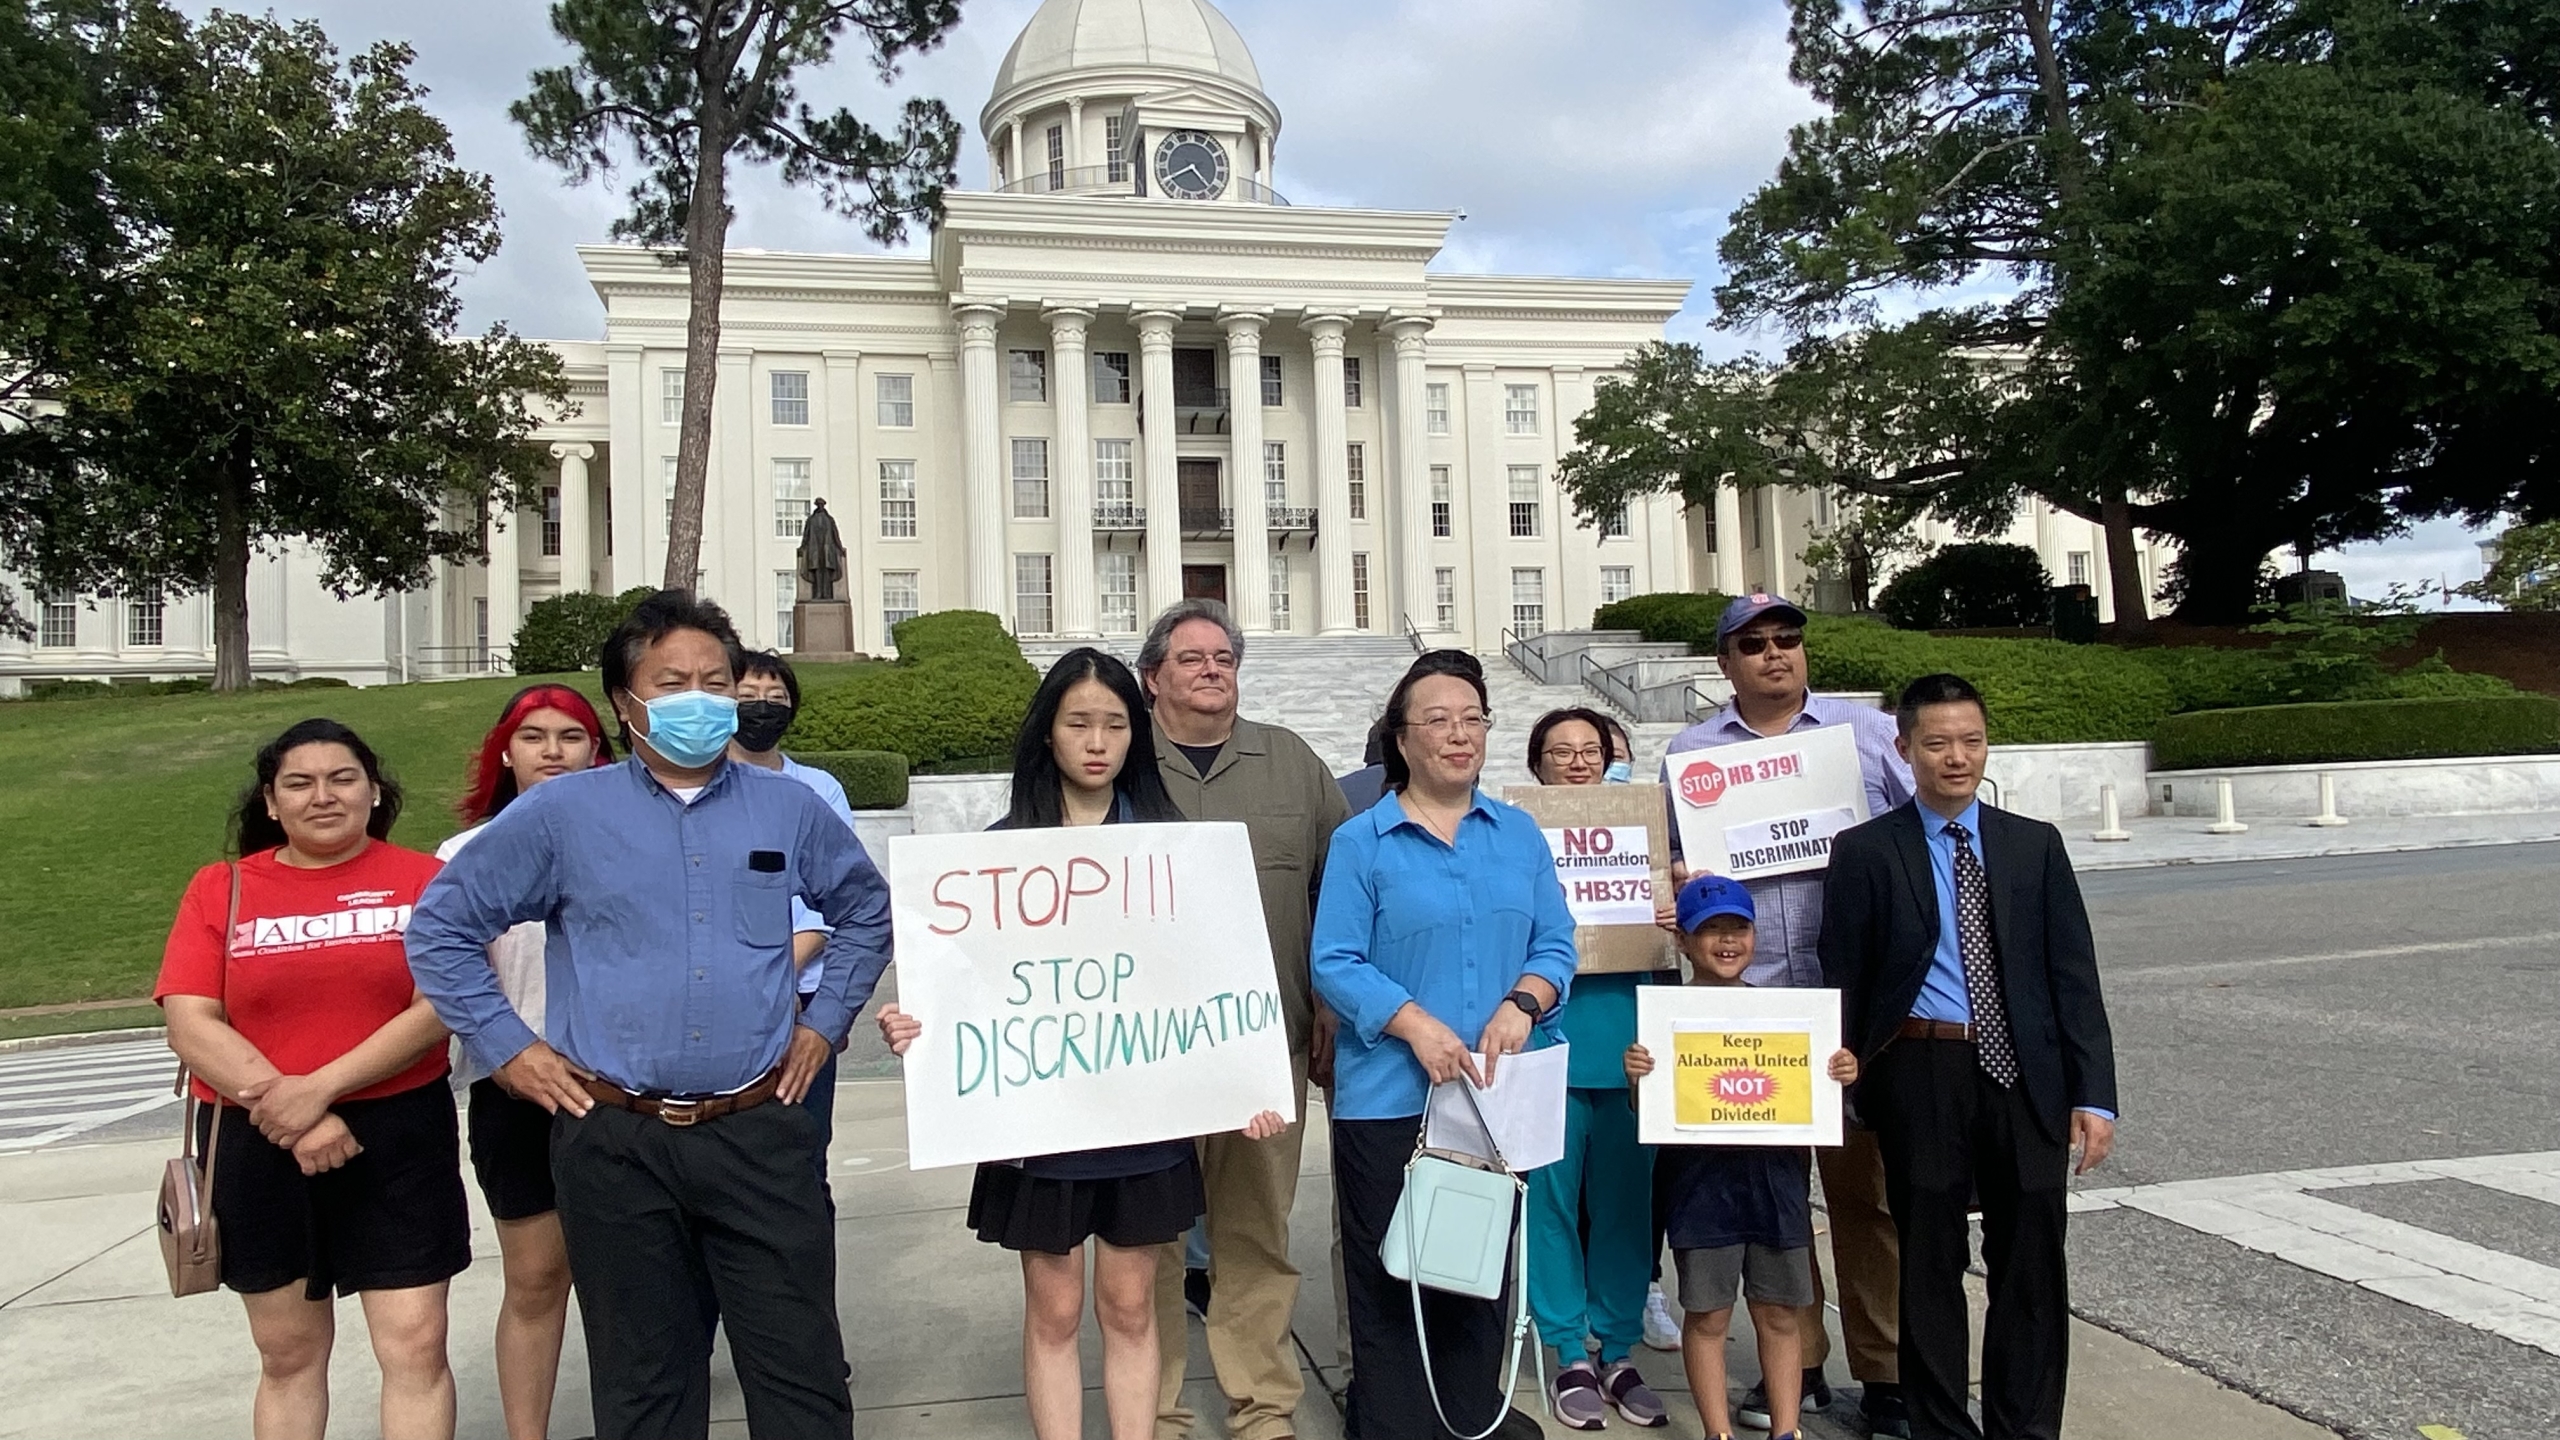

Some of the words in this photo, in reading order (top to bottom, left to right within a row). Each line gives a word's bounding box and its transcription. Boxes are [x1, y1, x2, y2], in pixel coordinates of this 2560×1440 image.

[1682, 772, 1723, 795] STOP
[1727, 763, 1755, 787] HB
[1756, 754, 1800, 780] 379!
[1769, 818, 1809, 841] STOP
[1563, 828, 1614, 856] NO
[1554, 852, 1650, 869] crimination
[928, 854, 1176, 936] STOP!!!
[1574, 879, 1653, 903] HB379
[1006, 953, 1135, 1006] STOP
[956, 990, 1279, 1098] DISCRIMINATION
[1722, 1034, 1763, 1051] Keep
[1677, 1053, 1748, 1068] Alabama
[1754, 1053, 1809, 1068] United
[1719, 1077, 1766, 1096] NOT
[1710, 1107, 1777, 1122] Divided!
